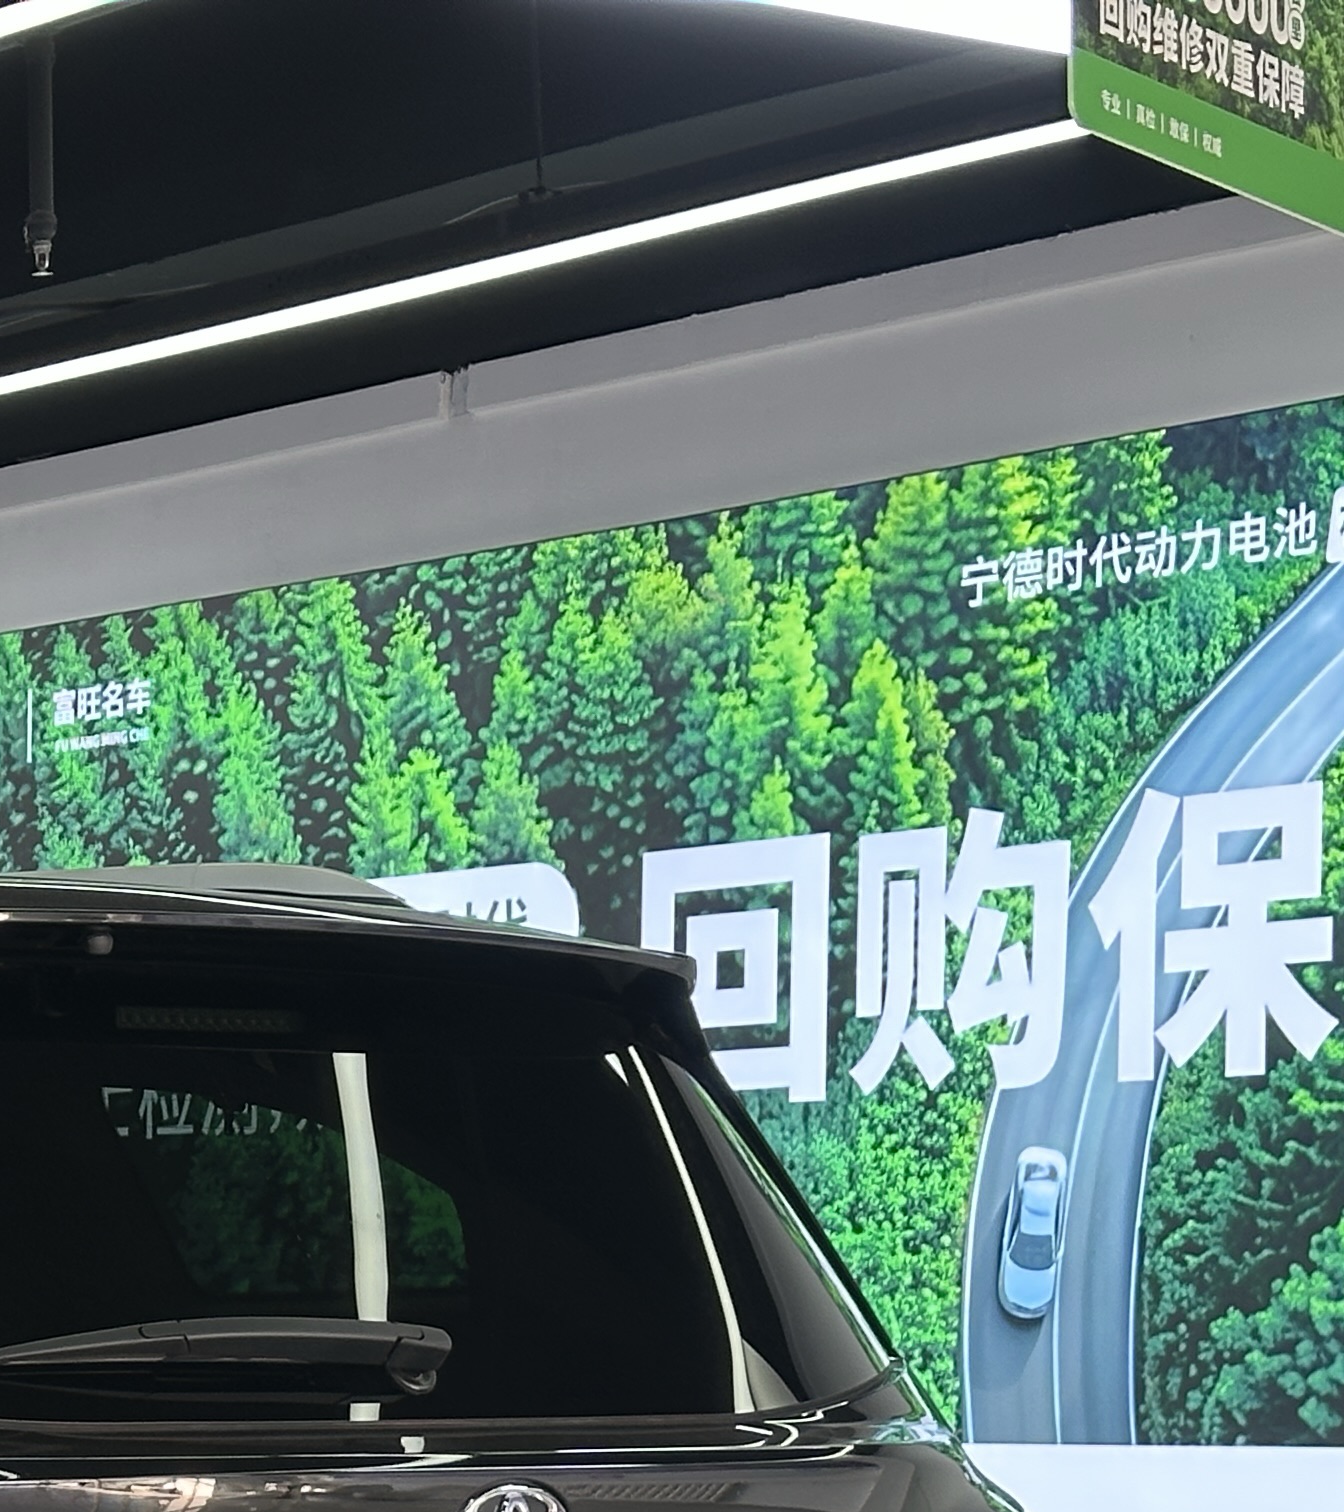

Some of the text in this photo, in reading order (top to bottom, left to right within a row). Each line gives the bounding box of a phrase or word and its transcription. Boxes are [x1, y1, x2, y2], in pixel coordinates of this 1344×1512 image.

[1099, 0, 1305, 119] 回购维修双重保障
[1101, 89, 1121, 115] 专业
[960, 502, 1317, 608] 宁德时代动力电池
[53, 677, 151, 726] 富旺名车
[643, 780, 1341, 1102] 回购保
